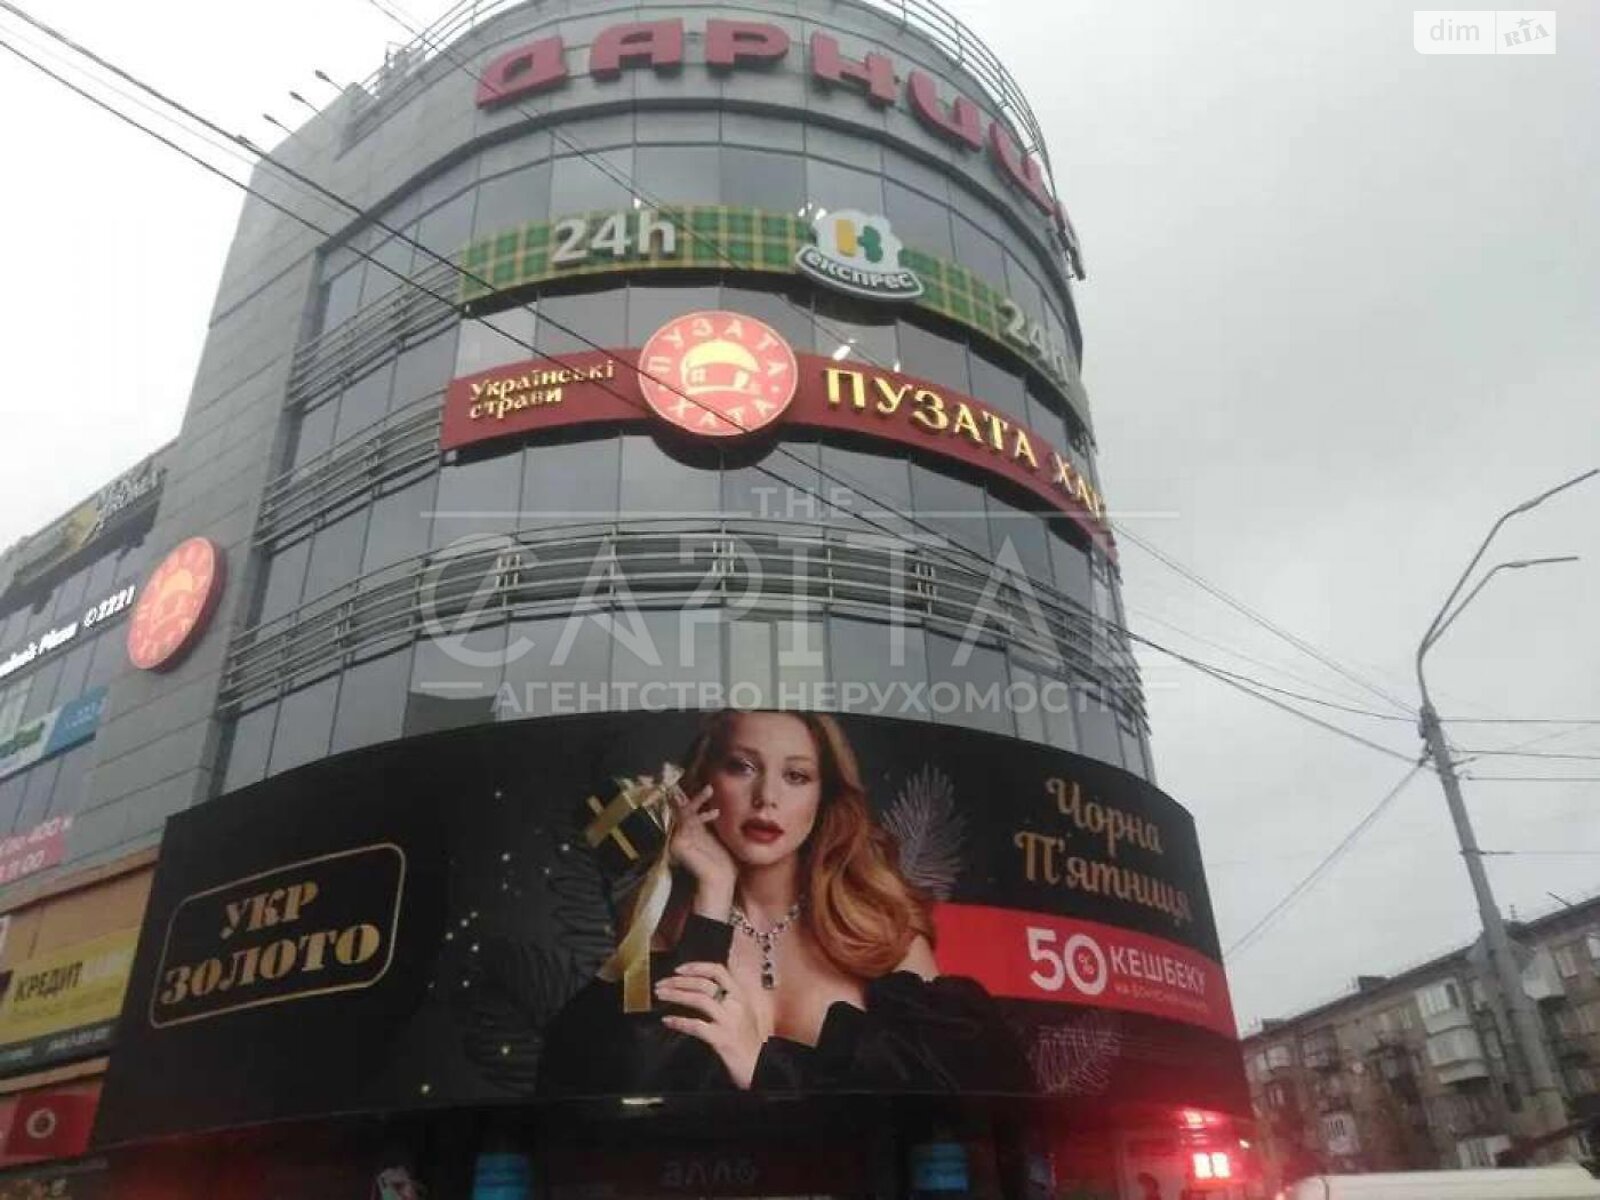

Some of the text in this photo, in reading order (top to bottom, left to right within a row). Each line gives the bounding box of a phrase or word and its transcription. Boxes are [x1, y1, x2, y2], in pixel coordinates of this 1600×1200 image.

[476, 17, 1084, 281] ДАРНИЦ
[551, 209, 676, 263] 24h
[468, 387, 562, 419] страви
[469, 359, 614, 401] Українські
[825, 368, 1039, 470] ПУЗАТА
[1045, 777, 1164, 858] Чорна
[219, 880, 320, 940] УКР
[161, 923, 381, 1005] ЗОЛОТО
[1109, 945, 1206, 996] КЕШБЕКУ
